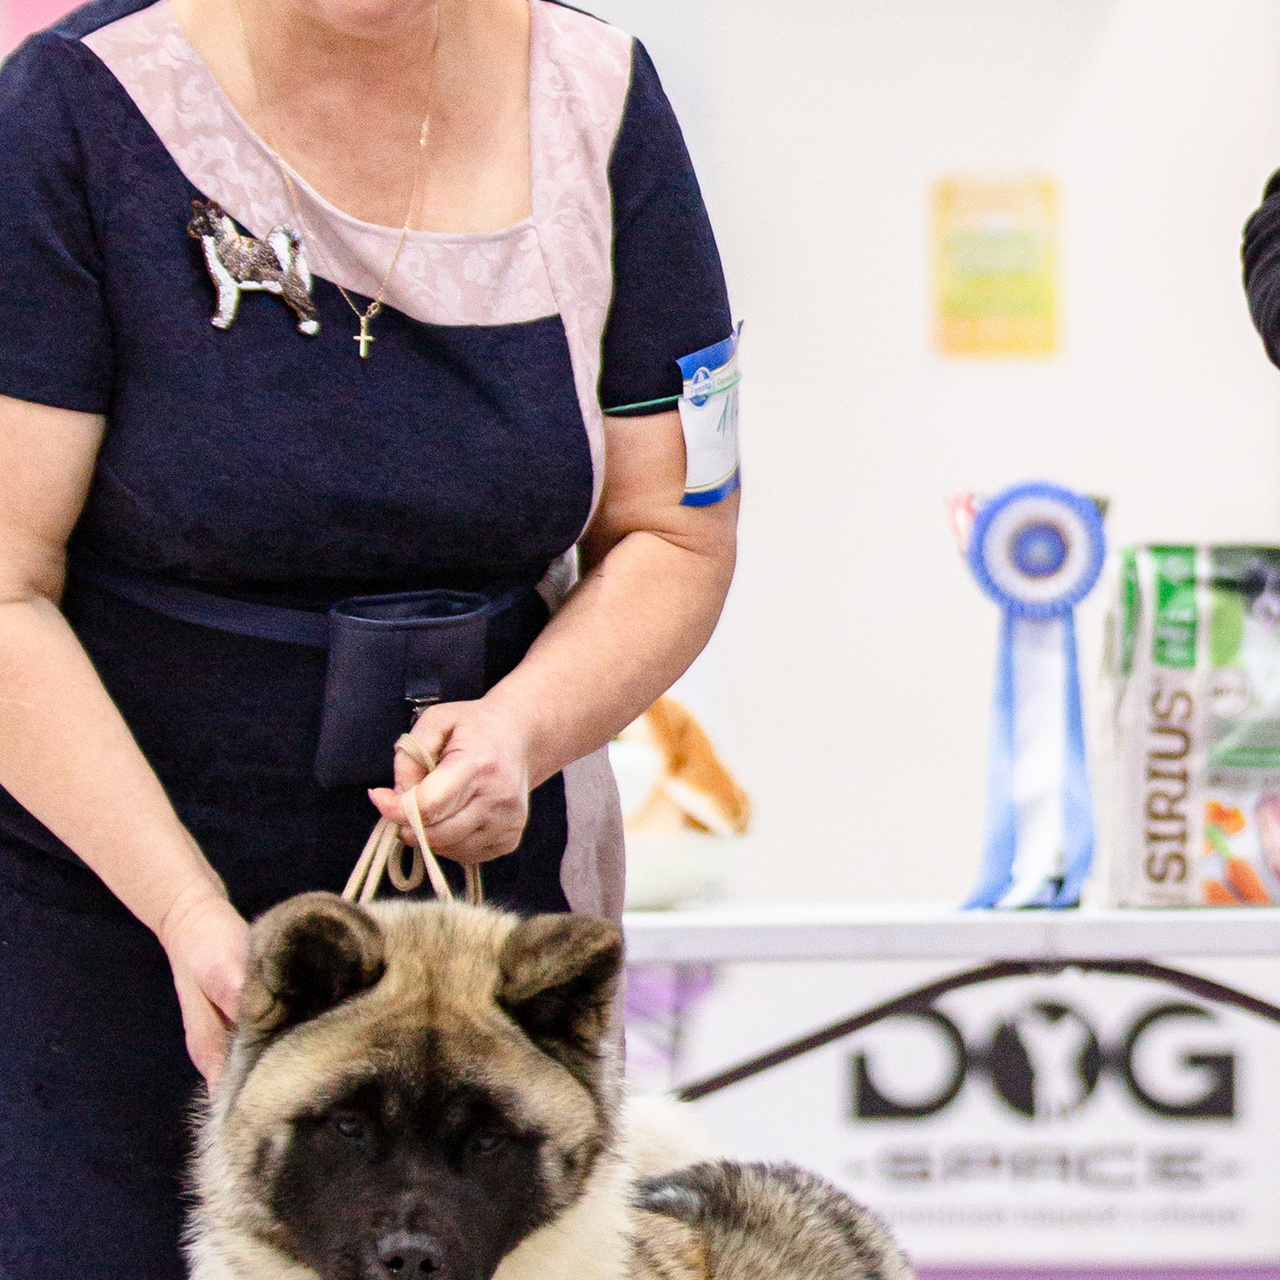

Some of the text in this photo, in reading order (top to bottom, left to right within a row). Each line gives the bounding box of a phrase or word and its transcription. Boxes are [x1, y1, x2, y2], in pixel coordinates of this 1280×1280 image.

[1146, 688, 1195, 884] SIRIUS
[855, 1000, 1237, 1120] DOG
[876, 1144, 1207, 1190] SPACE
